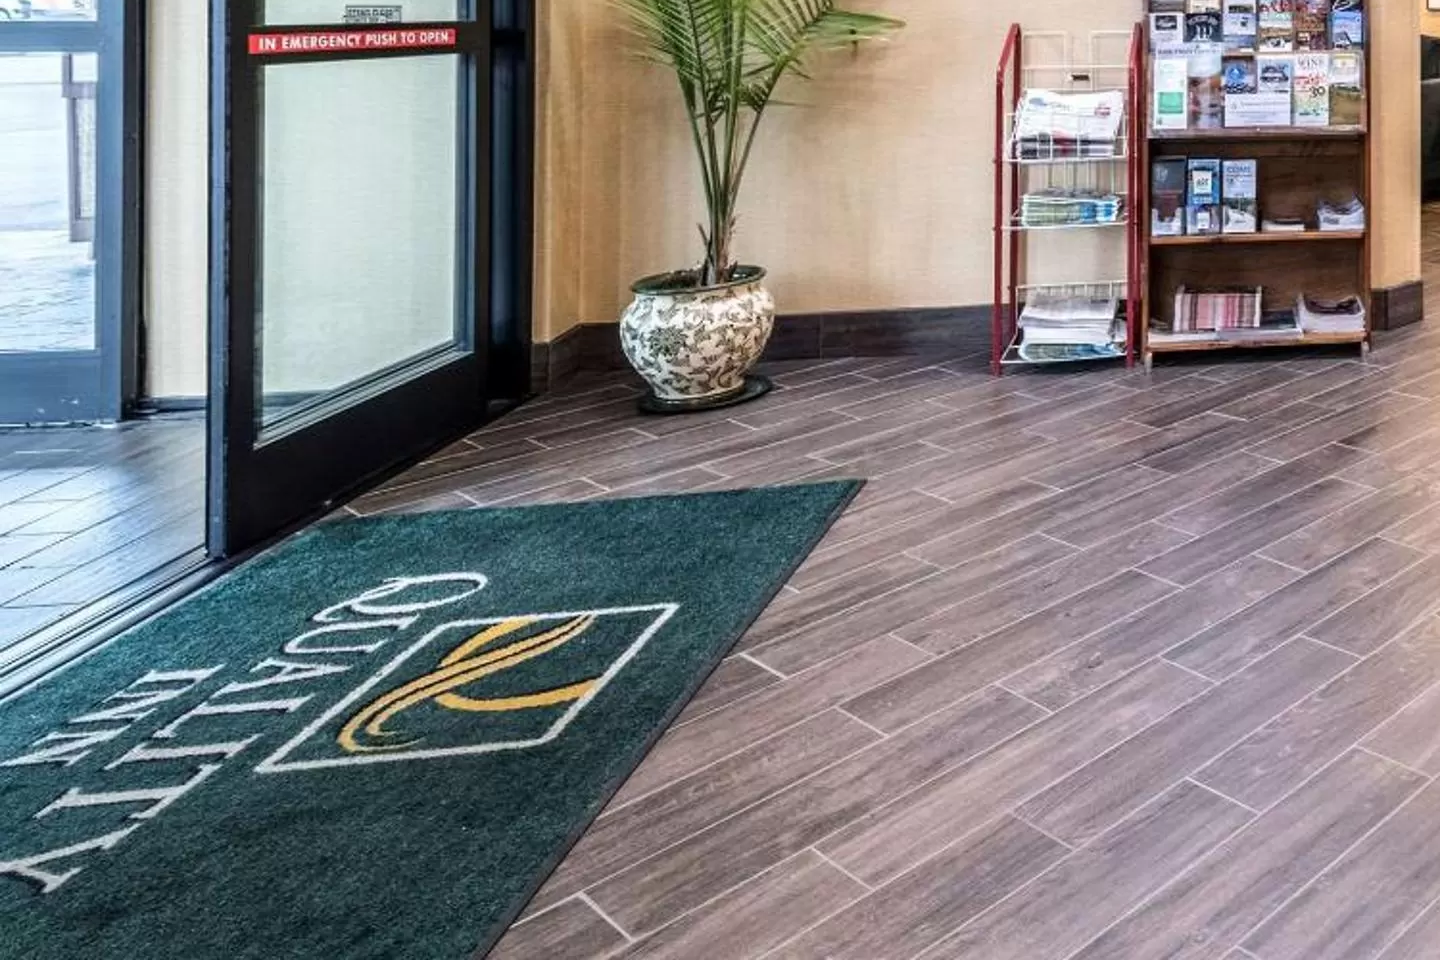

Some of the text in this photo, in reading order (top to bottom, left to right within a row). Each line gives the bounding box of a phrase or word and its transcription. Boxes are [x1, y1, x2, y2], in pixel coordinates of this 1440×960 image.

[259, 31, 449, 50] IN EMERGENCY PUSH TO OPEN
[0, 663, 228, 767] INN
[0, 572, 488, 893] QUALITY
